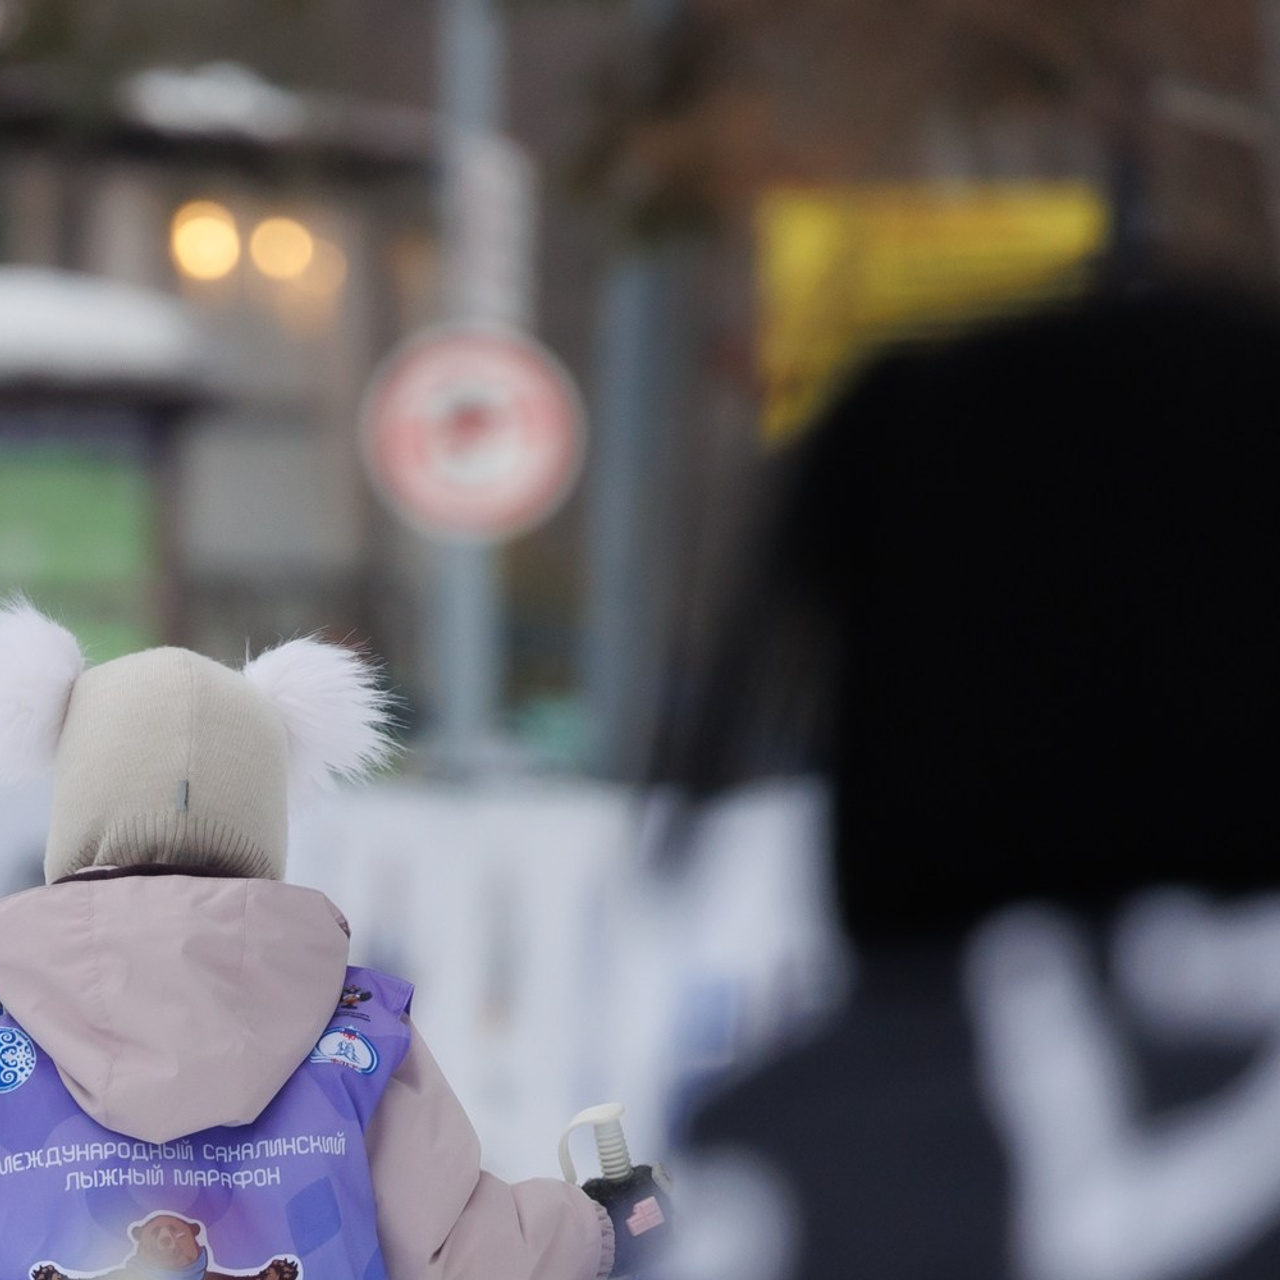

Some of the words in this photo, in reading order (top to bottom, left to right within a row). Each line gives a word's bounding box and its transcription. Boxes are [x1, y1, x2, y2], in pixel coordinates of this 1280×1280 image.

[202, 1131, 346, 1163] САХАЛИНСКИЙ
[65, 1164, 164, 1191] ЛЫЖНЫЙ
[174, 1166, 281, 1189] МАРАФОН
